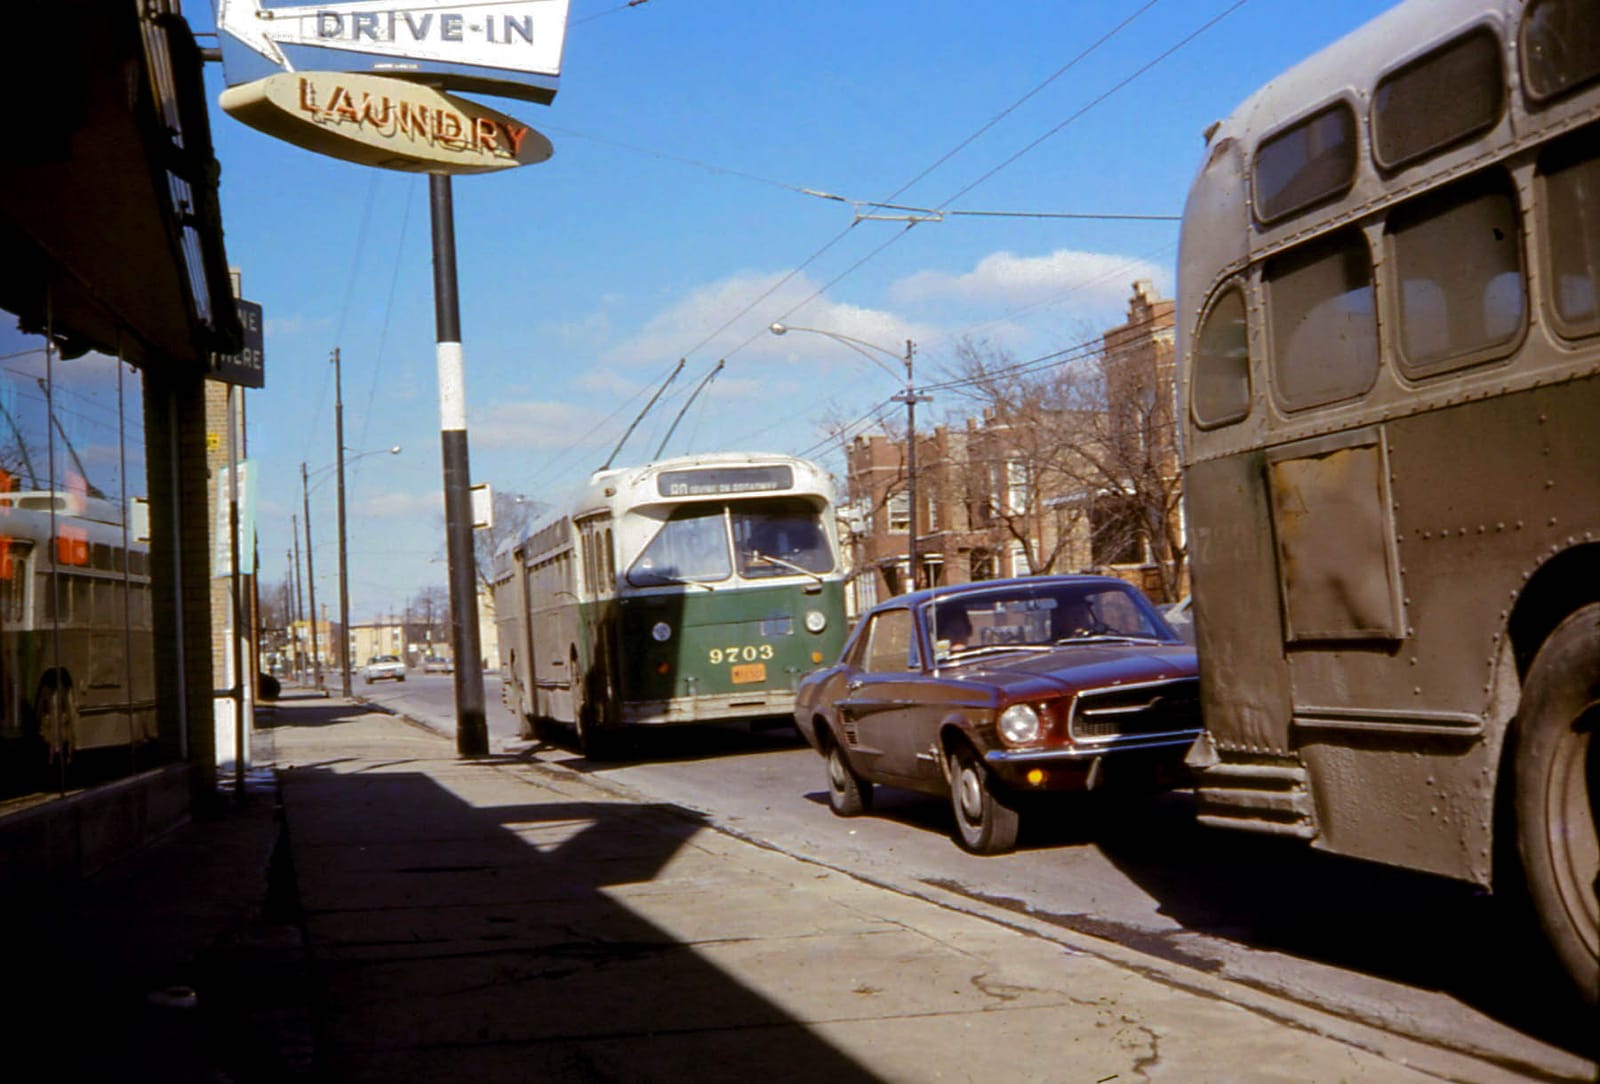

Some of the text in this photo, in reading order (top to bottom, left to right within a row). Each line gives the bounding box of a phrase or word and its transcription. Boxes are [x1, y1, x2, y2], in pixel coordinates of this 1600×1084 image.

[316, 9, 534, 45] DRIVE-IN
[299, 77, 529, 159] LAUNDRY
[709, 644, 774, 664] 9703
